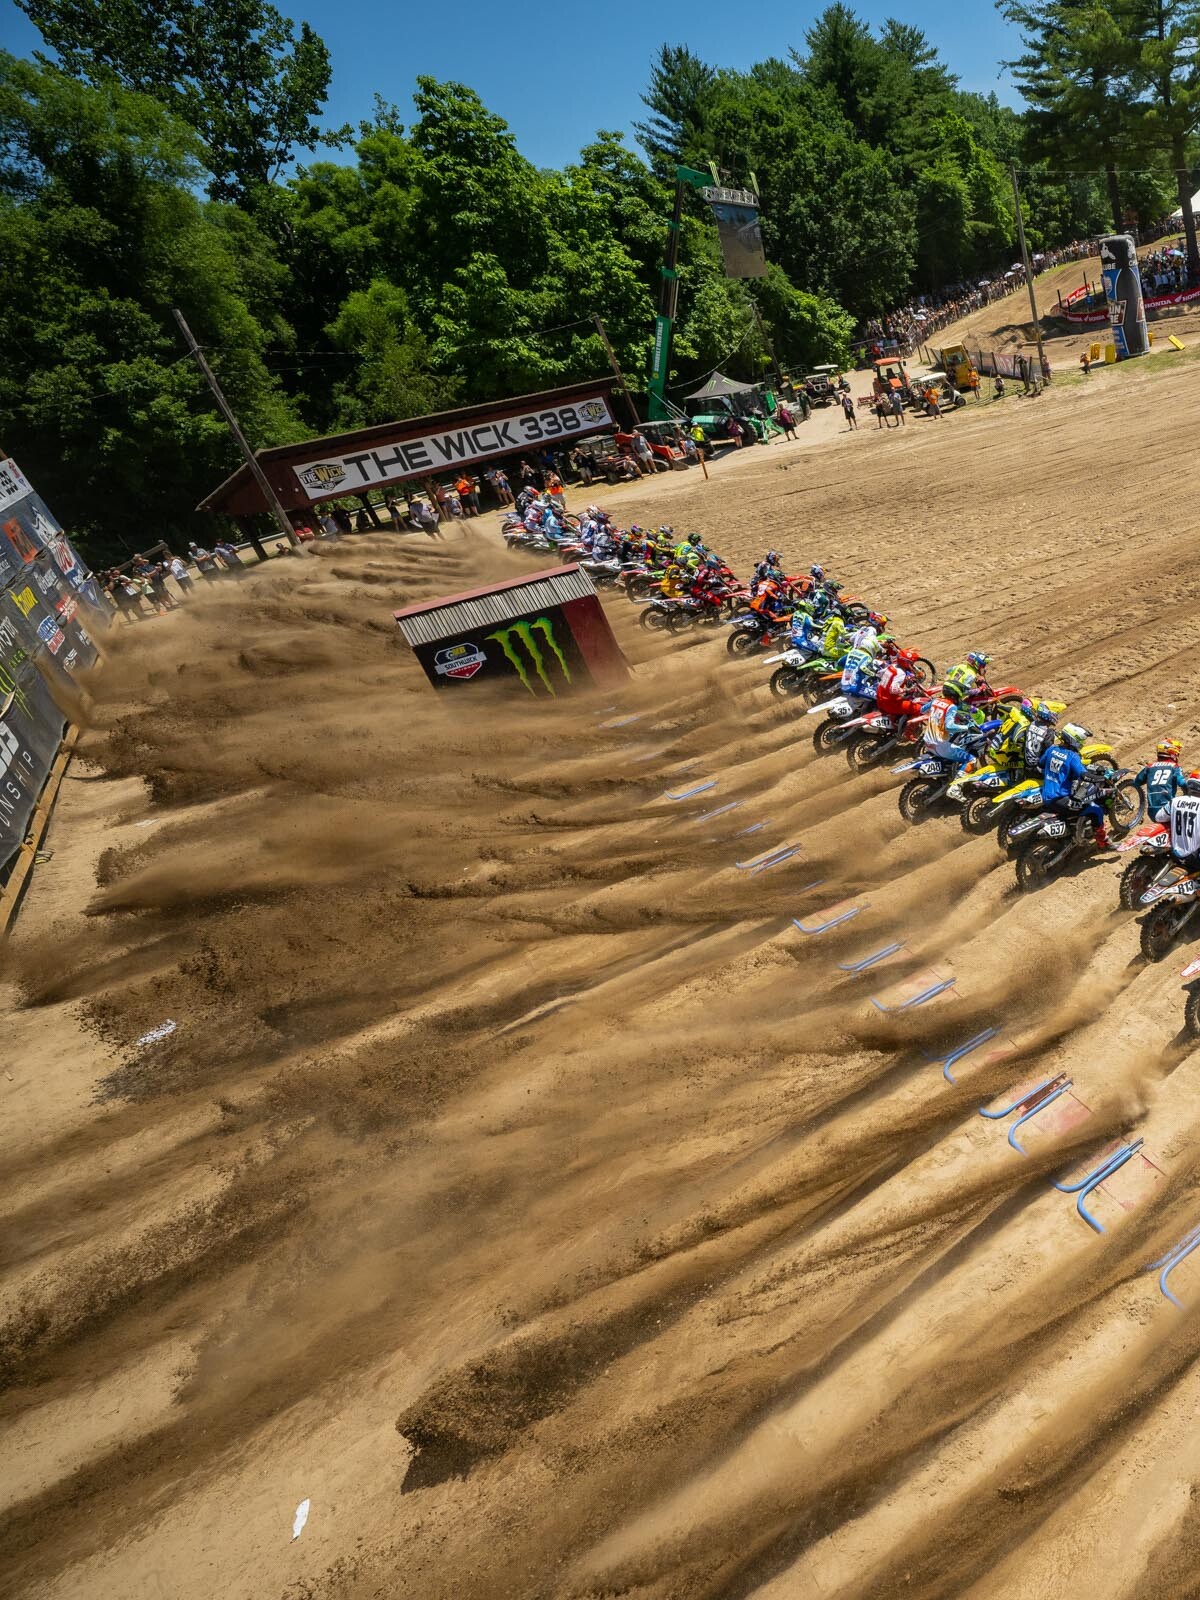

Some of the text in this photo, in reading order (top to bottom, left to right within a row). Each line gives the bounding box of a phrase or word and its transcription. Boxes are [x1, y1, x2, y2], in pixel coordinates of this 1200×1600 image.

[1144, 299, 1172, 310] HONDA
[343, 408, 582, 482] THE WICK 338
[444, 656, 478, 670] SOUTHWICK
[790, 658, 799, 666] 26
[838, 706, 847, 715] 35
[1151, 769, 1172, 786] 92
[1176, 800, 1200, 811] LAMPI
[1050, 822, 1066, 835] 637
[1176, 810, 1198, 838] 813
[1156, 834, 1167, 846] 92
[1177, 881, 1195, 894] 813
